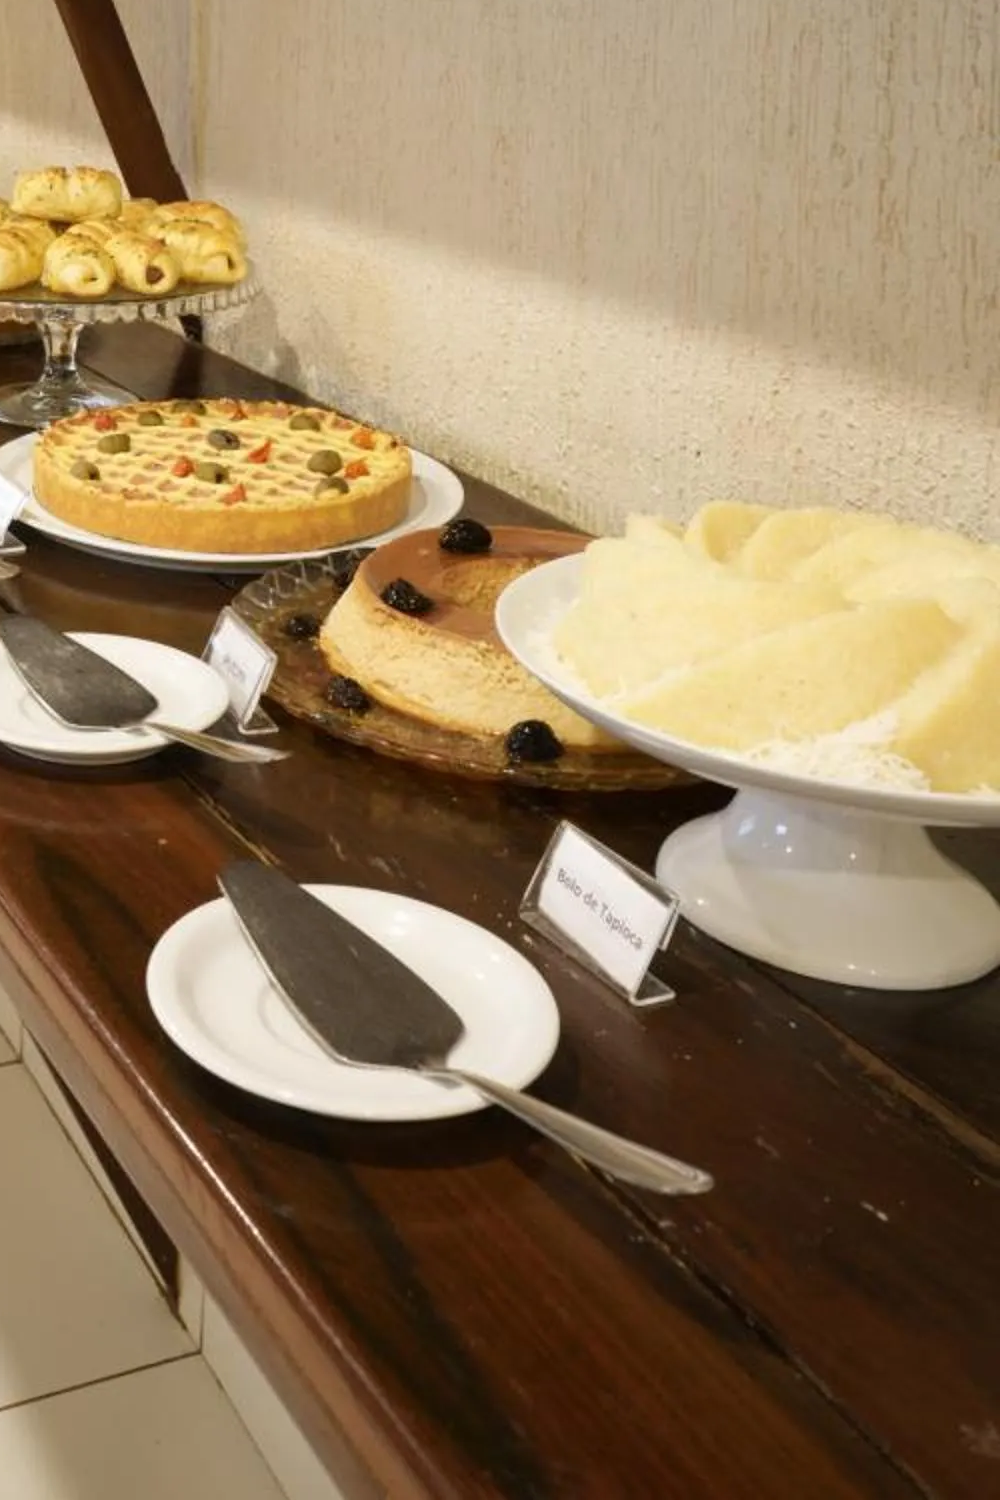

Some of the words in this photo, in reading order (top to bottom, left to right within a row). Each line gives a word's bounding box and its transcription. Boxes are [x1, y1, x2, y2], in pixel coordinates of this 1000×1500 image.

[557, 867, 583, 897] Bolo
[583, 891, 599, 913] de
[600, 902, 643, 950] Tapioca
